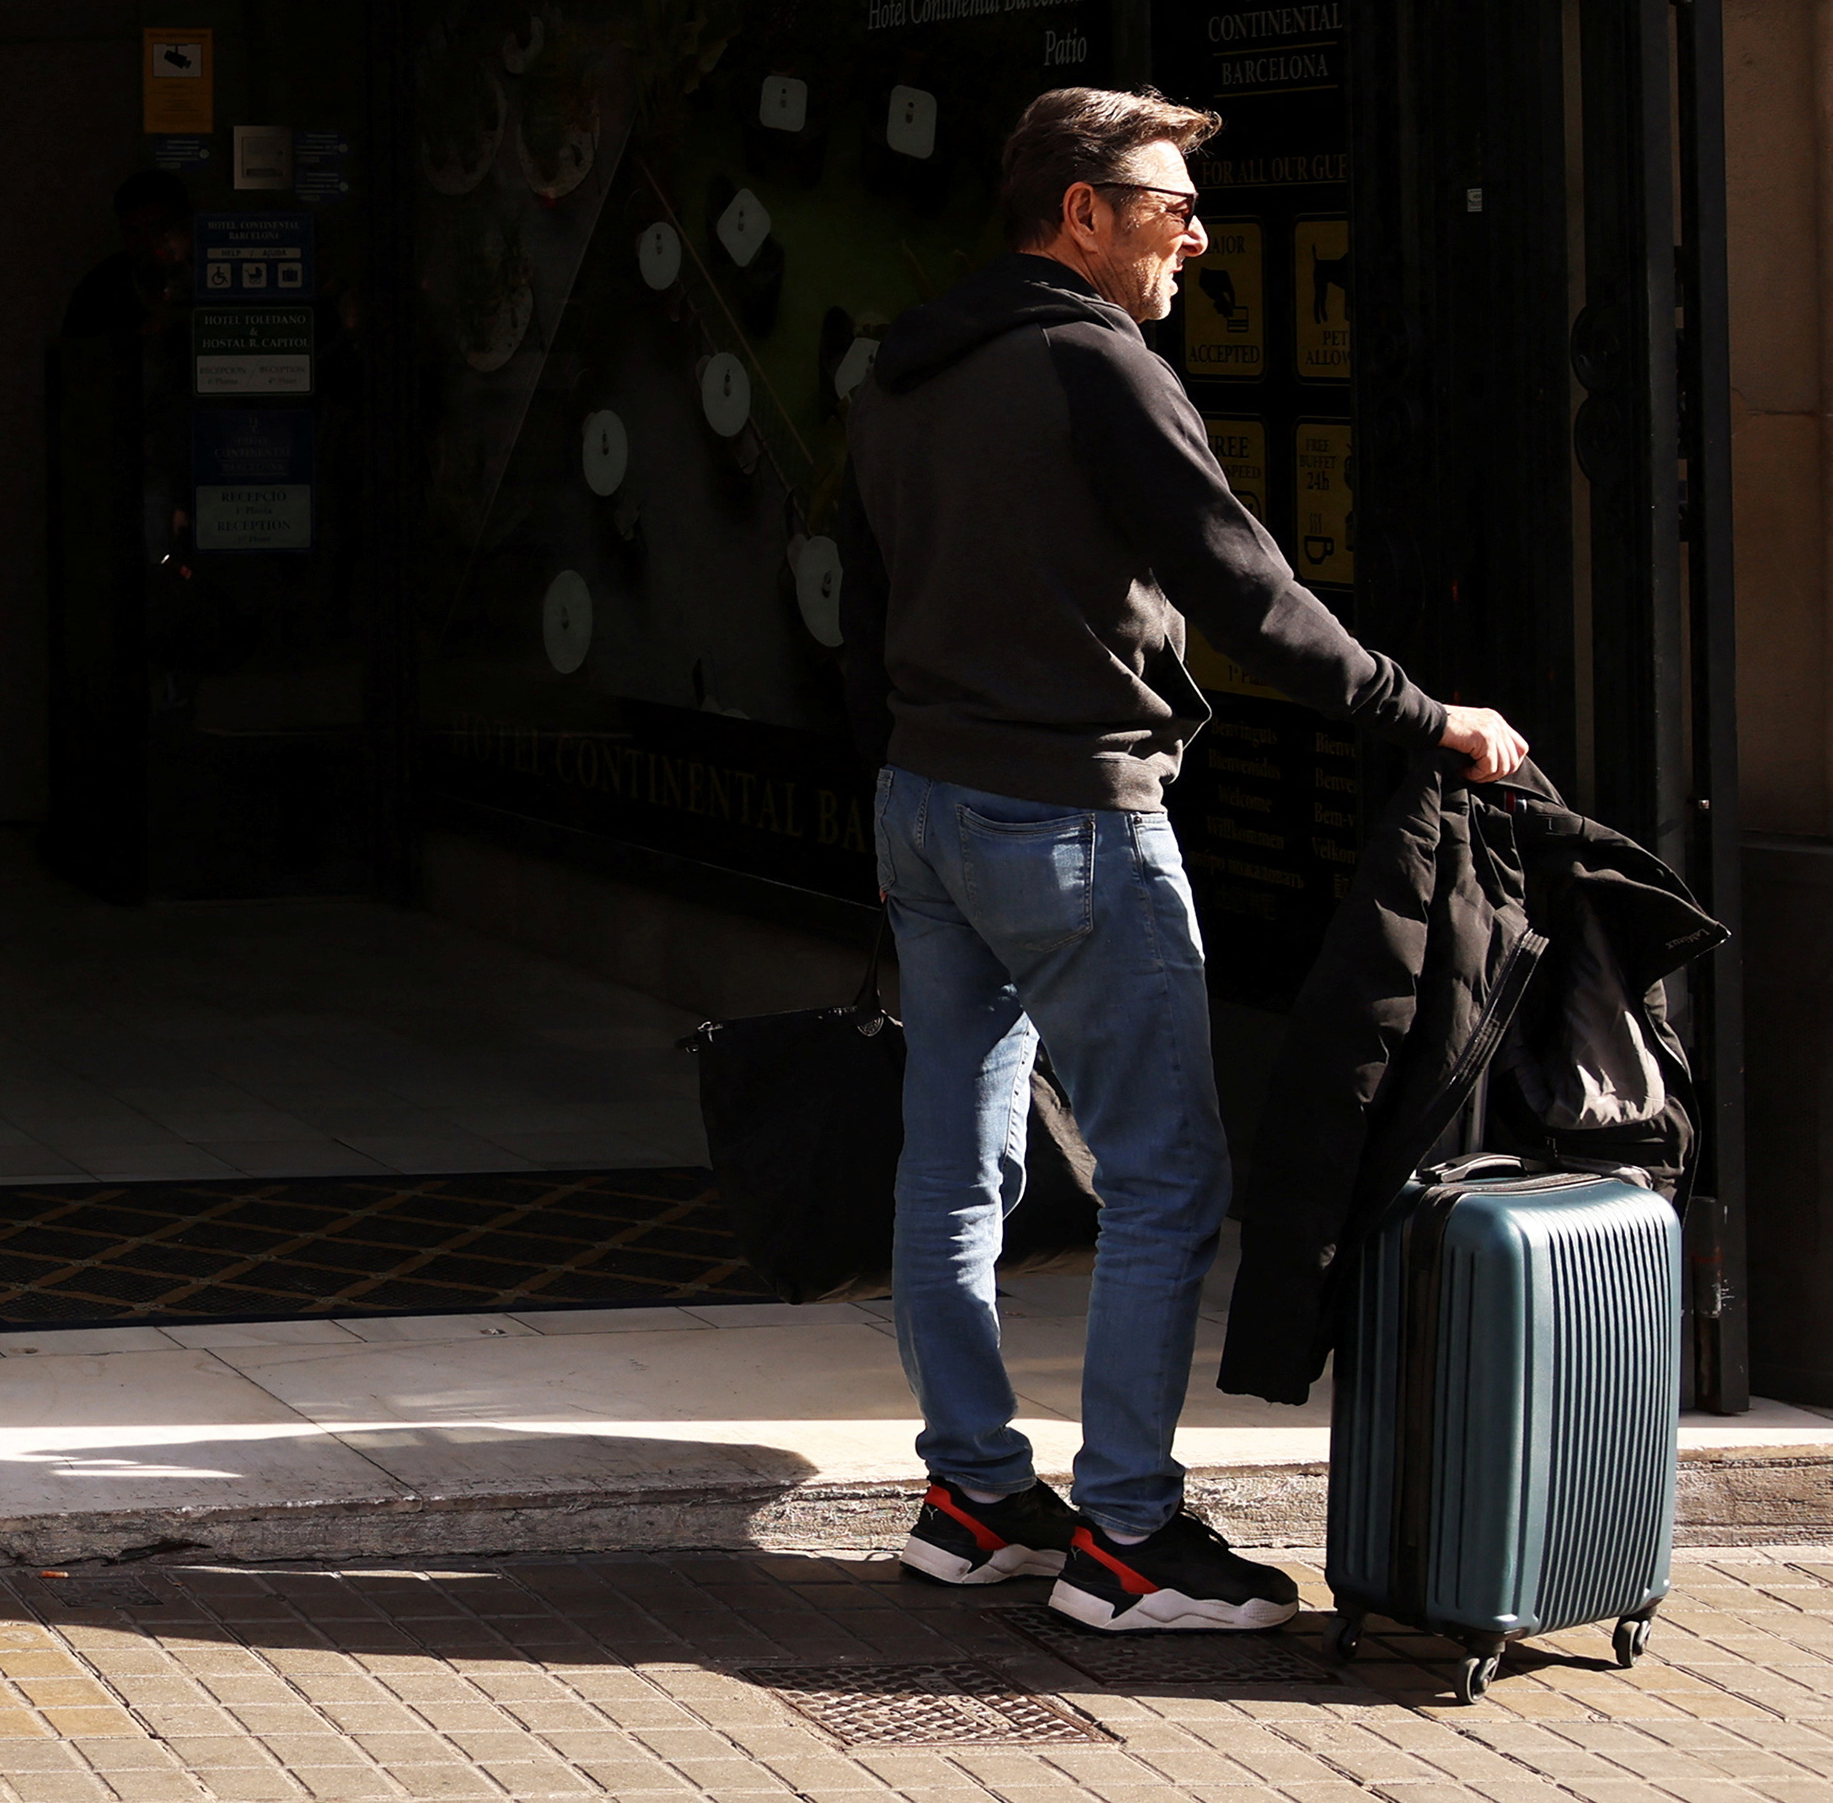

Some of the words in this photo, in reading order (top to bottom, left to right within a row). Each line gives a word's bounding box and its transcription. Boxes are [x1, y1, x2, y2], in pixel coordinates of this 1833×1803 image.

[1207, 3, 1343, 43] CONTINENTAL
[1042, 28, 1088, 68] Patio
[1221, 53, 1330, 87] BARCELONA
[1201, 160, 1233, 185] FOR
[1237, 158, 1267, 184] ALL
[1270, 156, 1309, 182] OUR
[207, 220, 237, 230] HOTEL
[240, 220, 300, 230] CONTINENTAL
[228, 231, 280, 240] BARCELONA
[1208, 235, 1246, 255] AJOR
[221, 249, 241, 257] HELP
[204, 315, 241, 325] HOTEL
[245, 315, 307, 325] TOLEDANO
[202, 338, 246, 349] HOSTAL
[261, 338, 310, 348] CAPITOL
[1189, 344, 1261, 364] ACCEPTED
[1305, 438, 1329, 453] FREE
[1225, 464, 1261, 480] SPEED
[1300, 454, 1336, 470] BUFFET
[1307, 471, 1330, 491] 24h
[221, 489, 287, 502] RECEPCIÓ
[217, 520, 292, 532] RECEPTION
[1211, 716, 1278, 748] Benvinguts
[1207, 747, 1282, 781] Bienvenidos
[450, 711, 546, 776] HOTEL
[553, 733, 804, 839] CONTINENTAL
[816, 788, 868, 854] BA
[1217, 783, 1273, 814] Welcome
[1205, 814, 1286, 850] Willkommen
